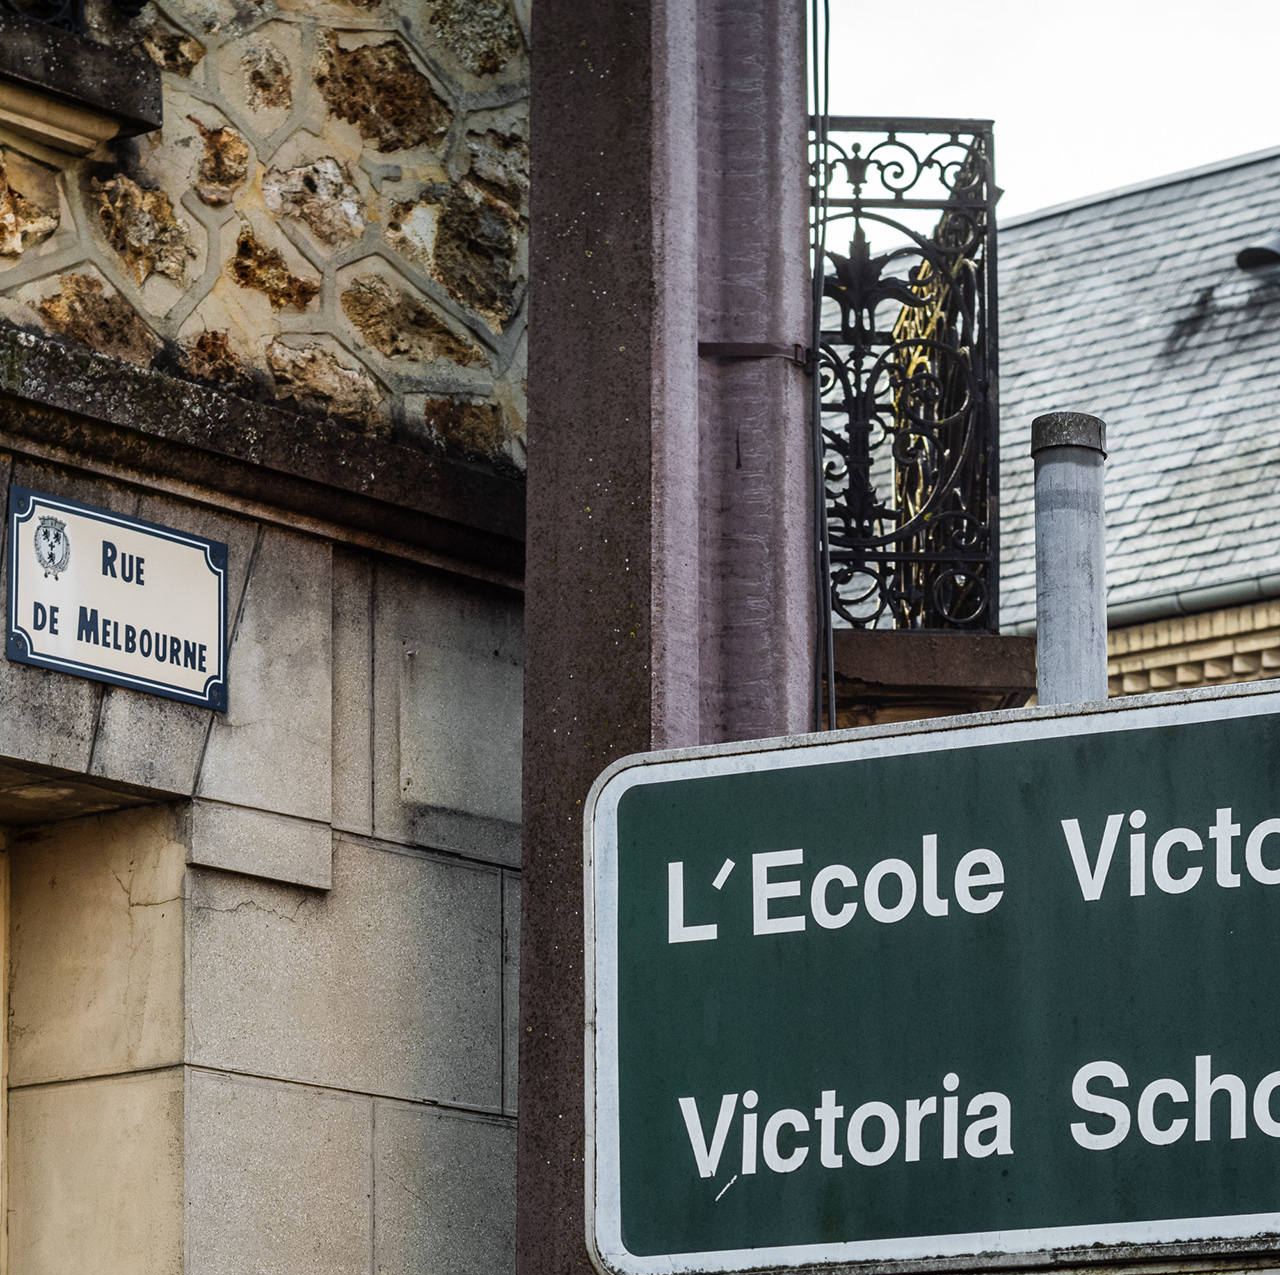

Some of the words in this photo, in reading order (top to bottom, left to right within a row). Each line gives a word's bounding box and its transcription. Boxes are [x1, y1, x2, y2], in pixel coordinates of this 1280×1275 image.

[101, 540, 145, 586] RUE
[33, 601, 59, 635] DE
[76, 606, 207, 673] MELBOURNE
[667, 833, 1005, 944] L'Ecole
[678, 1072, 1014, 1179] Victoria
